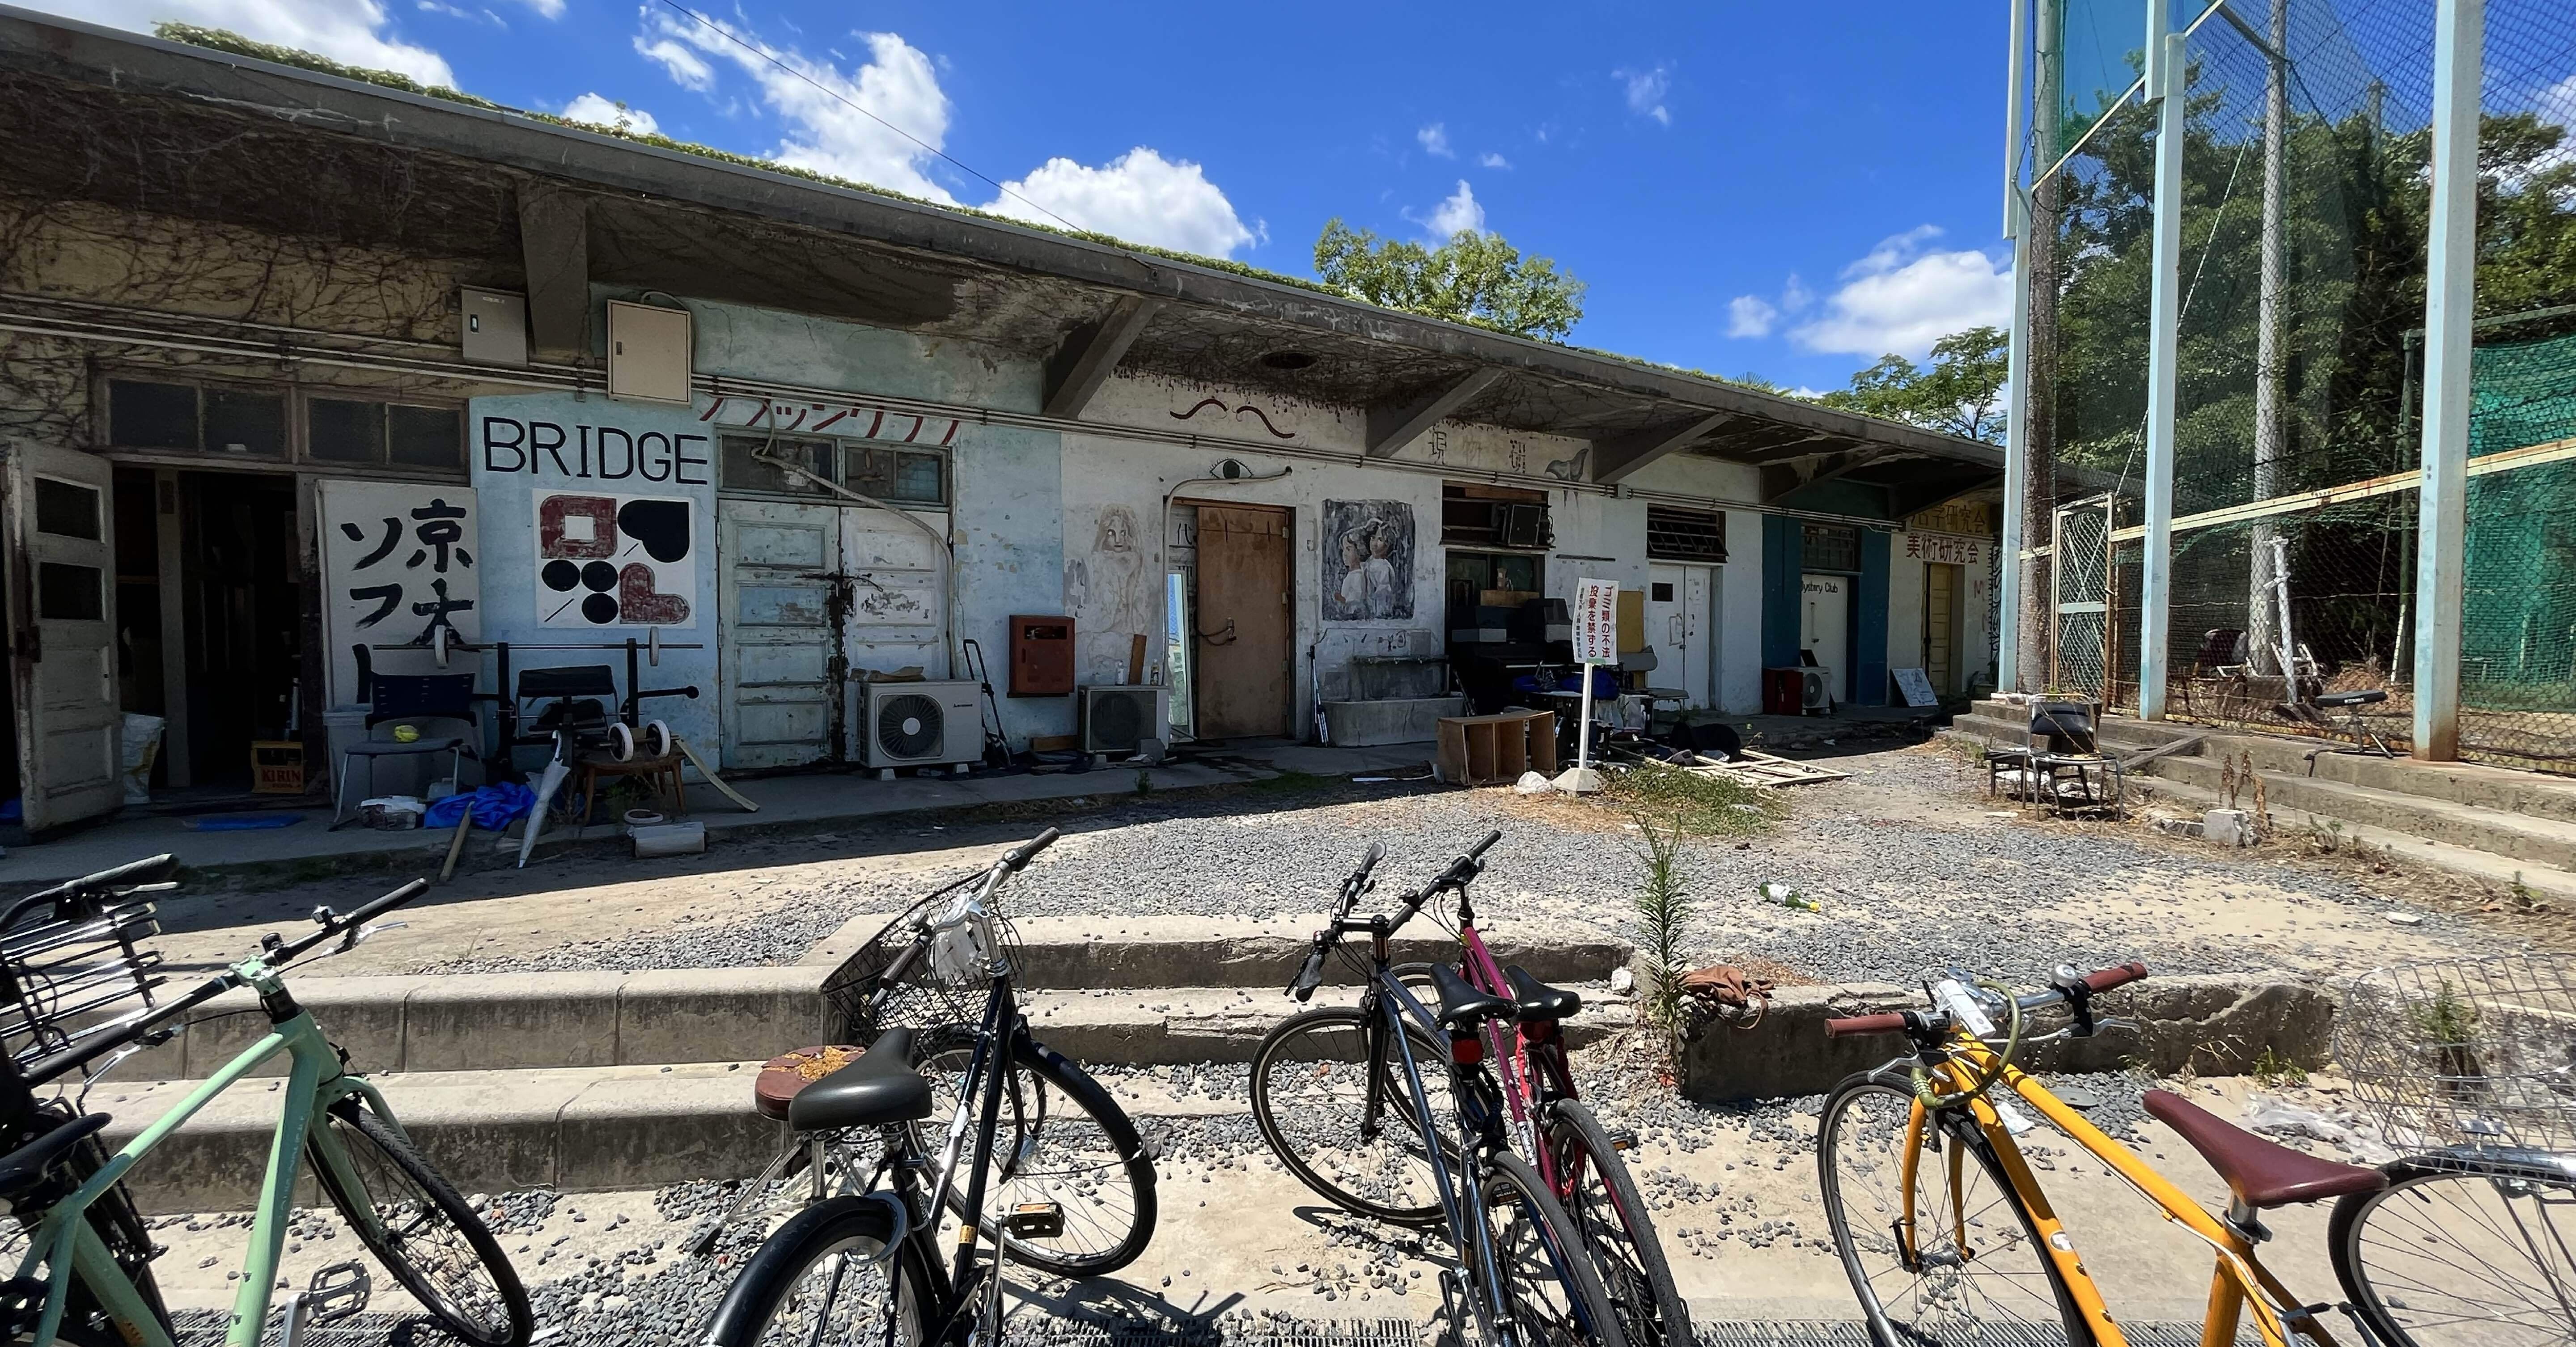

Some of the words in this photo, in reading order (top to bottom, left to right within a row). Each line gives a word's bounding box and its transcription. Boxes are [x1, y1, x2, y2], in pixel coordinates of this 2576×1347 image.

[483, 416, 708, 485] BRIDGE
[1906, 533, 1979, 564] 美術研究会
[1802, 581, 1822, 593] ystery
[1825, 582, 1838, 593] Club
[1602, 586, 1614, 658] ゴミ類の不法
[263, 769, 301, 781] KIRIN
